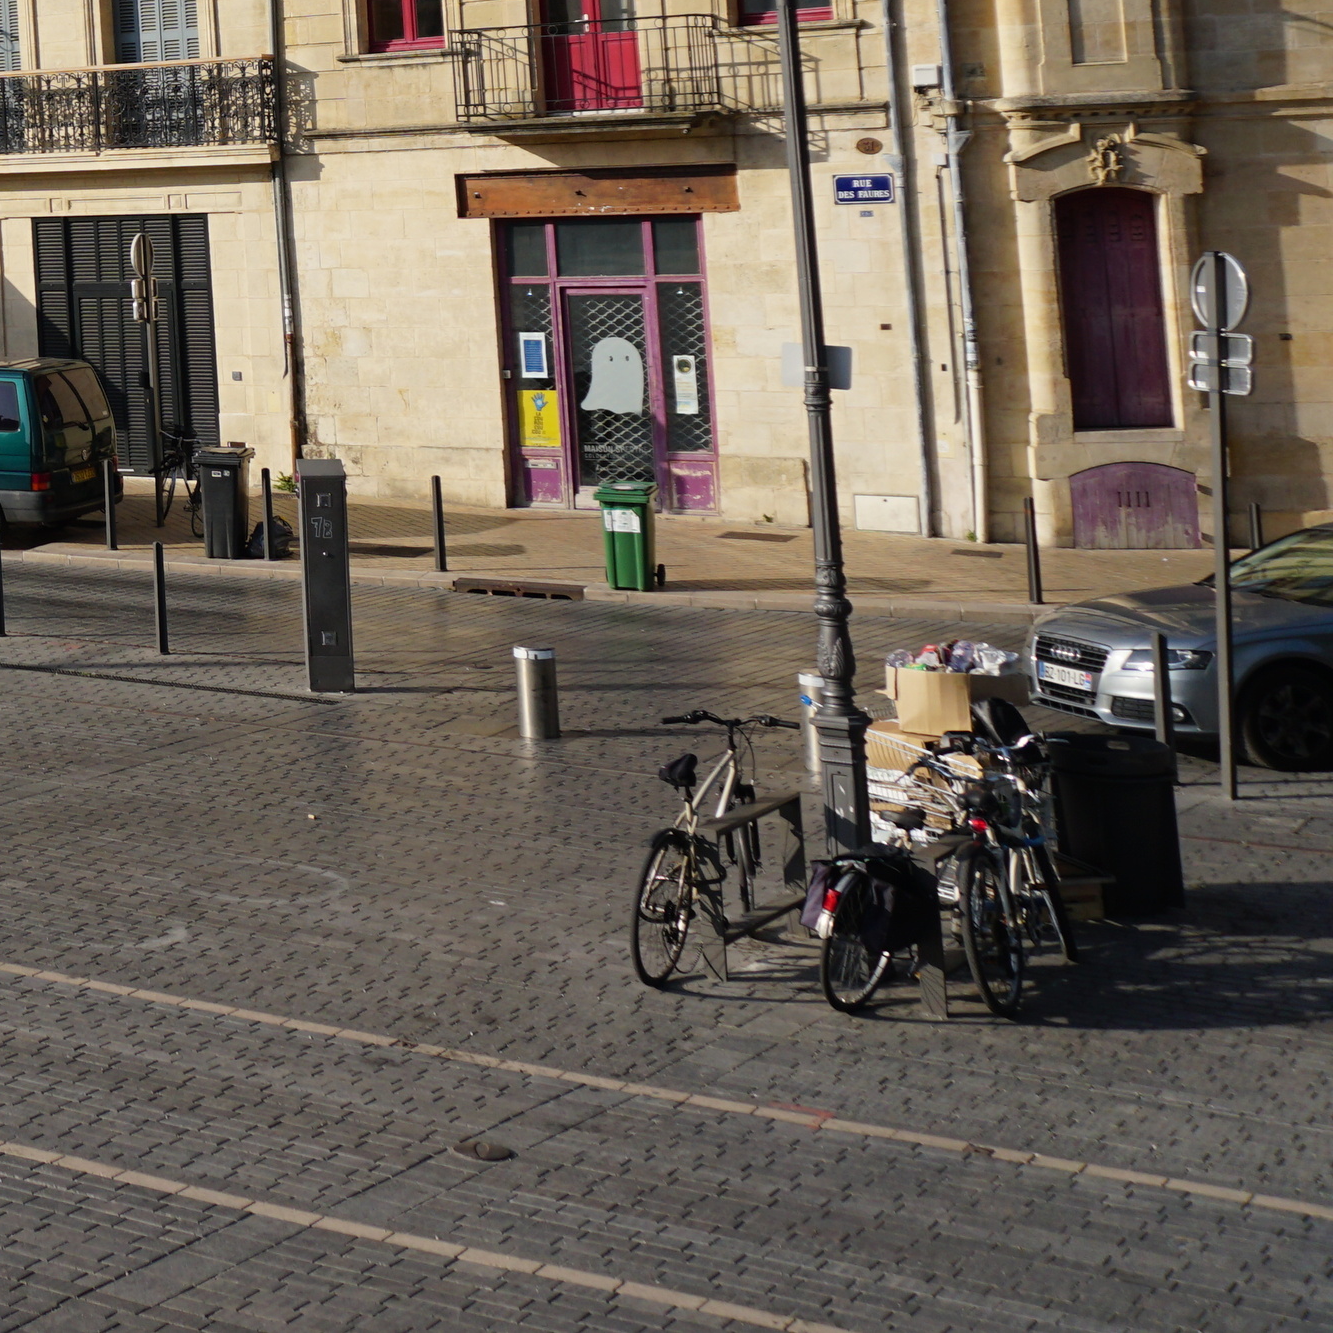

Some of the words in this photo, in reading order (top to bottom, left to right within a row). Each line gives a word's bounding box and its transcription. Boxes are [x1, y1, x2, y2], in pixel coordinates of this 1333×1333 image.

[852, 179, 873, 188] RUE
[838, 191, 855, 199] DES
[857, 190, 890, 198] FAURES
